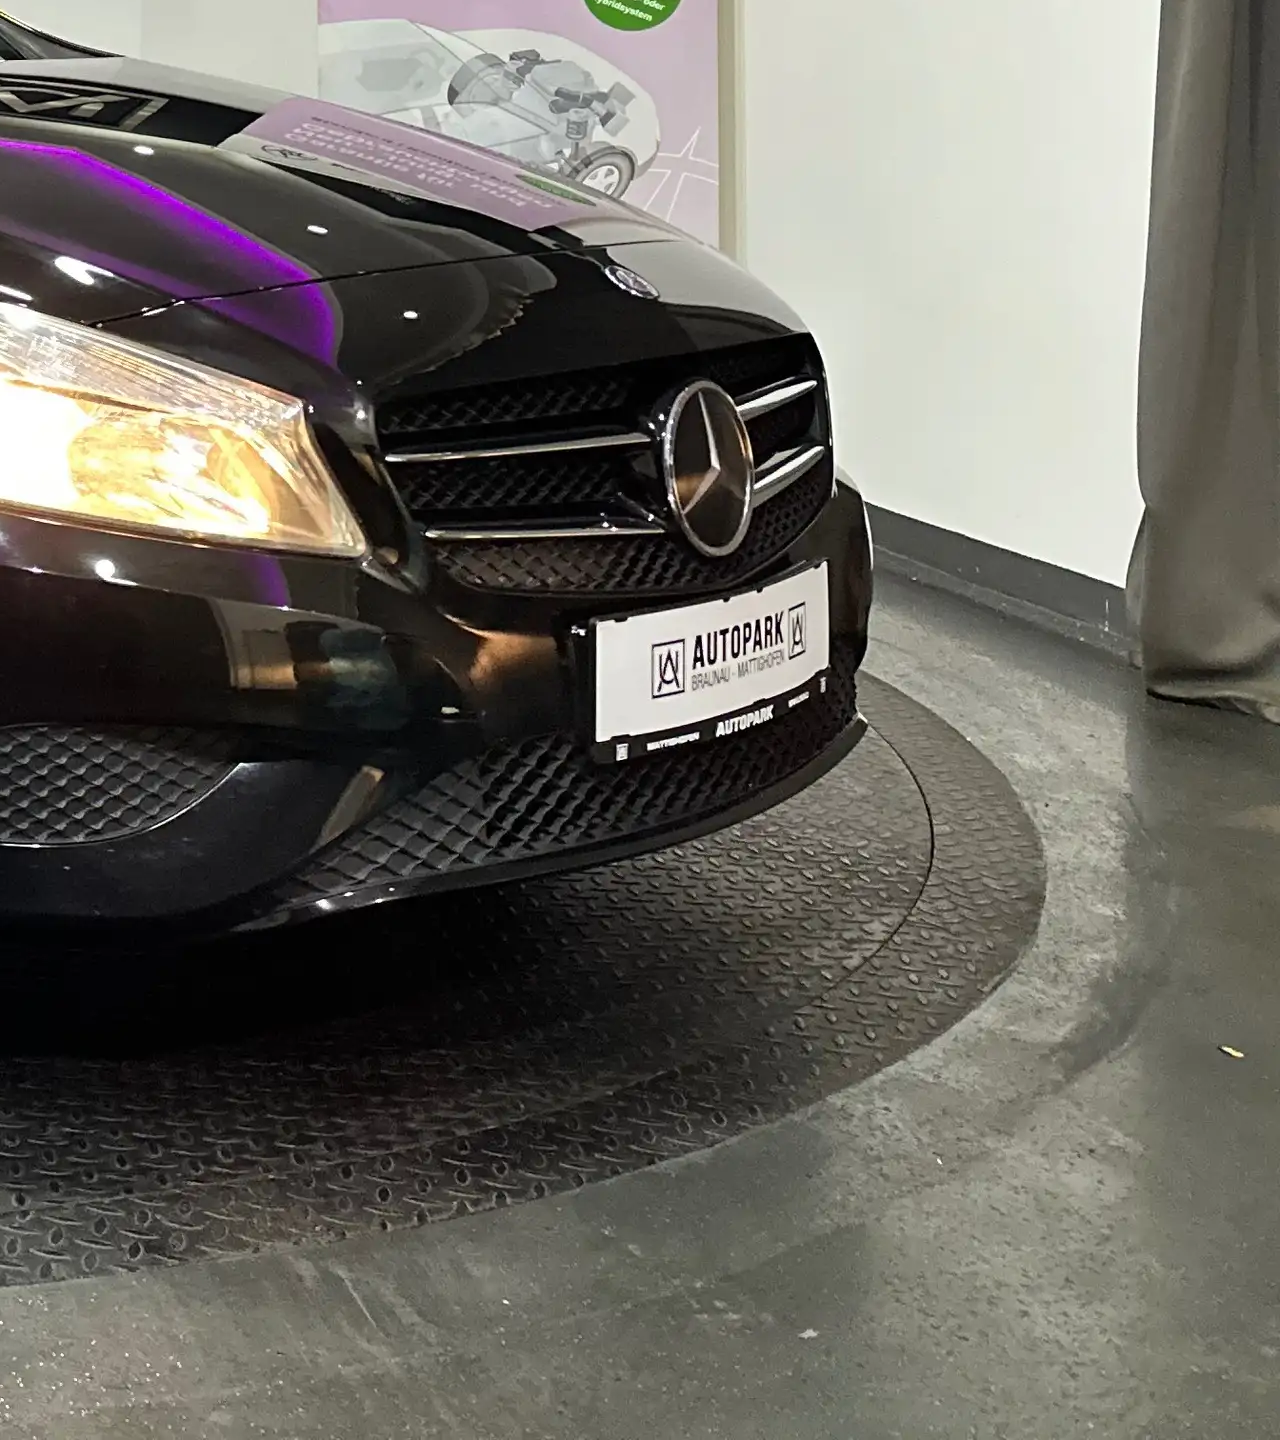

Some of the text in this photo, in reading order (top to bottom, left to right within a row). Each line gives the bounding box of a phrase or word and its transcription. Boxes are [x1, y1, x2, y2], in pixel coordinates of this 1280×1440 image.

[692, 610, 785, 671] AUTOPARK
[691, 666, 731, 691] BRAUNAU
[737, 648, 785, 679] MATTIGHOFEN
[715, 704, 774, 738] AUTOPARK
